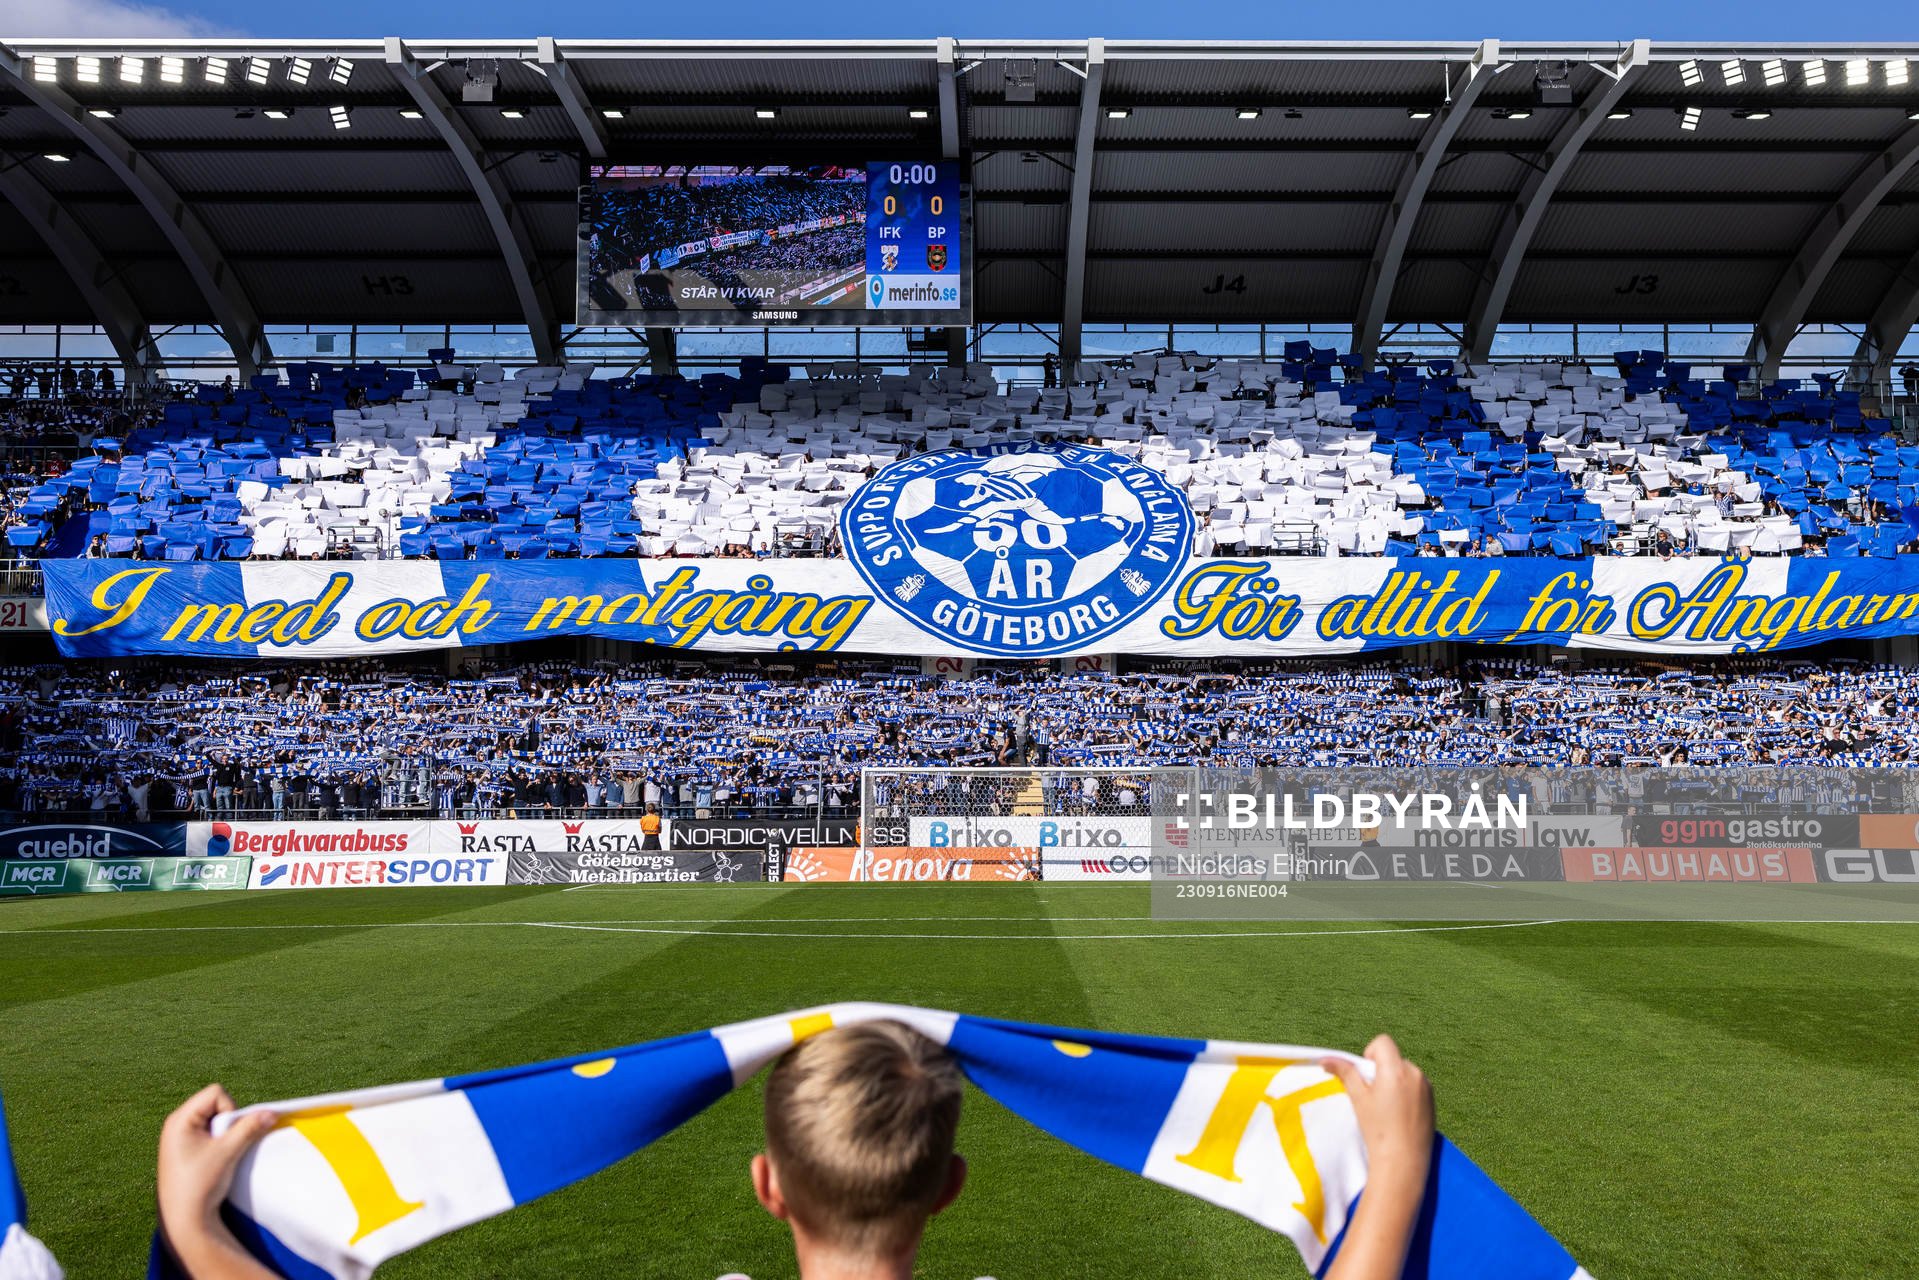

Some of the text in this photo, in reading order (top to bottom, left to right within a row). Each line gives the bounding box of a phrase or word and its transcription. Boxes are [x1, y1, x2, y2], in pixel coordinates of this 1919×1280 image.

[890, 164, 936, 184] 0:00
[884, 195, 943, 215] 0 0
[880, 227, 946, 238] IFK BP
[362, 275, 415, 296] H3
[681, 285, 776, 299] STÅR VI KVAR
[888, 282, 957, 301] merinfo.se
[1203, 274, 1248, 296] J4
[1615, 274, 1660, 295] J3
[752, 311, 798, 319] SAMSUNG
[973, 513, 1067, 552] 50
[986, 545, 1054, 600] ÅR
[161, 572, 353, 646] med
[355, 572, 499, 643] och
[523, 565, 873, 652] motgång
[1160, 560, 1304, 642] För
[1495, 570, 1616, 645] för
[1, 601, 28, 627] 21
[932, 595, 1120, 646] GÖTEBORG
[233, 828, 408, 857] Bergkvarabuss
[461, 835, 537, 852] RASTA
[565, 834, 642, 852] RASTA
[1414, 820, 1596, 847] morris law.
[18, 832, 111, 858] cuebid
[183, 863, 228, 879] MCR
[290, 857, 495, 886] INTERSPORT
[577, 853, 675, 869] Göteborgs
[768, 843, 780, 883] SELECT
[850, 850, 972, 882] Renova
[1392, 853, 1525, 878] ELEDA
[1591, 852, 1786, 879] BAUHAUS
[11, 866, 57, 882] MCR
[97, 864, 142, 881] MCR
[568, 868, 700, 884] Metallpartier
